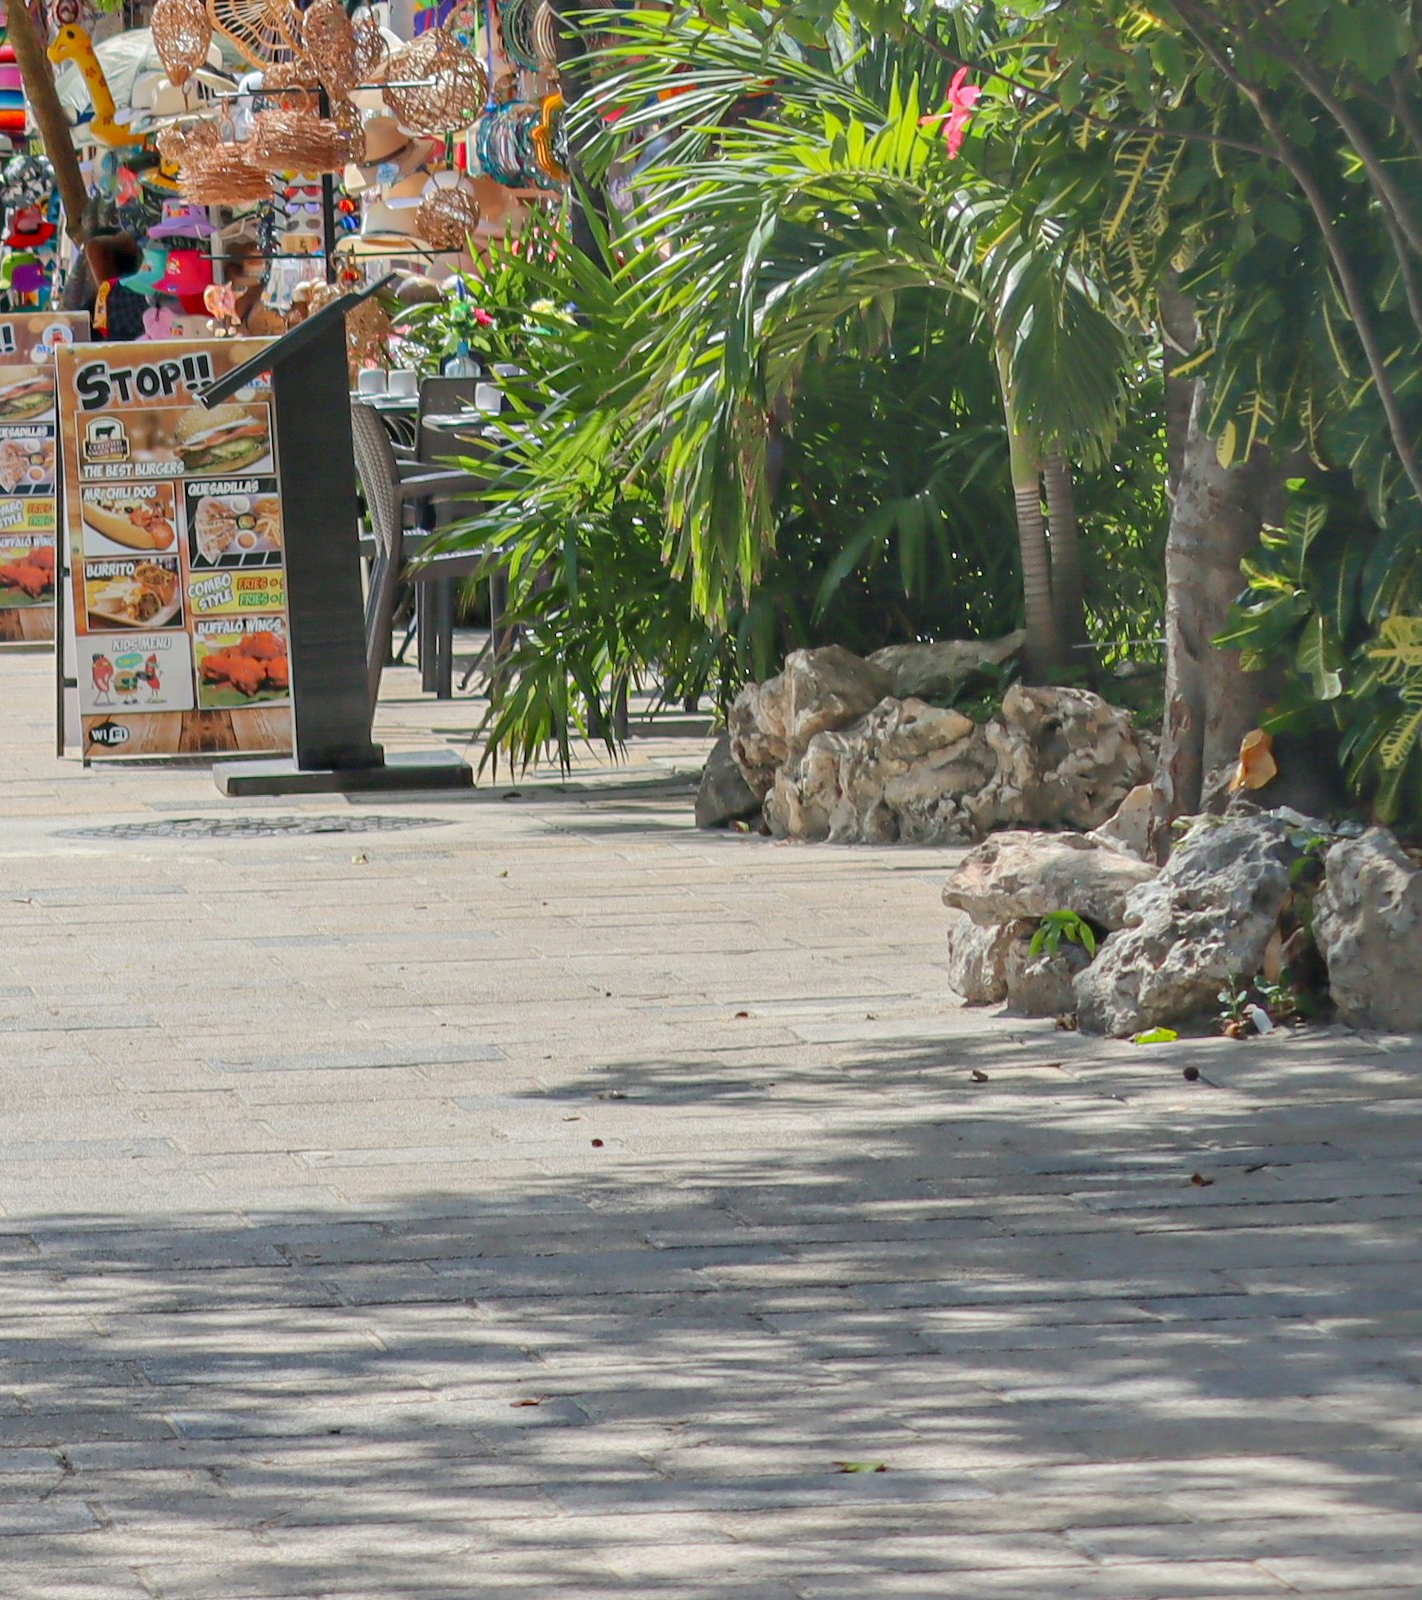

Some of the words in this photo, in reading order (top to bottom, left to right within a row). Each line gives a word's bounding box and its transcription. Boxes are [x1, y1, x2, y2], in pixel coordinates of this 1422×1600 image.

[75, 353, 214, 410] STOP!!
[83, 464, 103, 478] THE
[105, 463, 134, 478] BEST
[134, 460, 185, 476] BURGERS
[106, 486, 132, 499] CHILI
[133, 485, 157, 498] DOG
[187, 479, 259, 497] QUESADILLAS
[86, 562, 135, 578] BURRITO
[188, 572, 232, 598] COMBO
[237, 576, 268, 591] FRIES
[198, 588, 233, 612] STYLE
[239, 591, 269, 607] FRIES
[197, 619, 243, 635] BUFFALO
[245, 617, 282, 634] WINGS
[111, 639, 139, 652] KIDS
[139, 636, 173, 651] MENU
